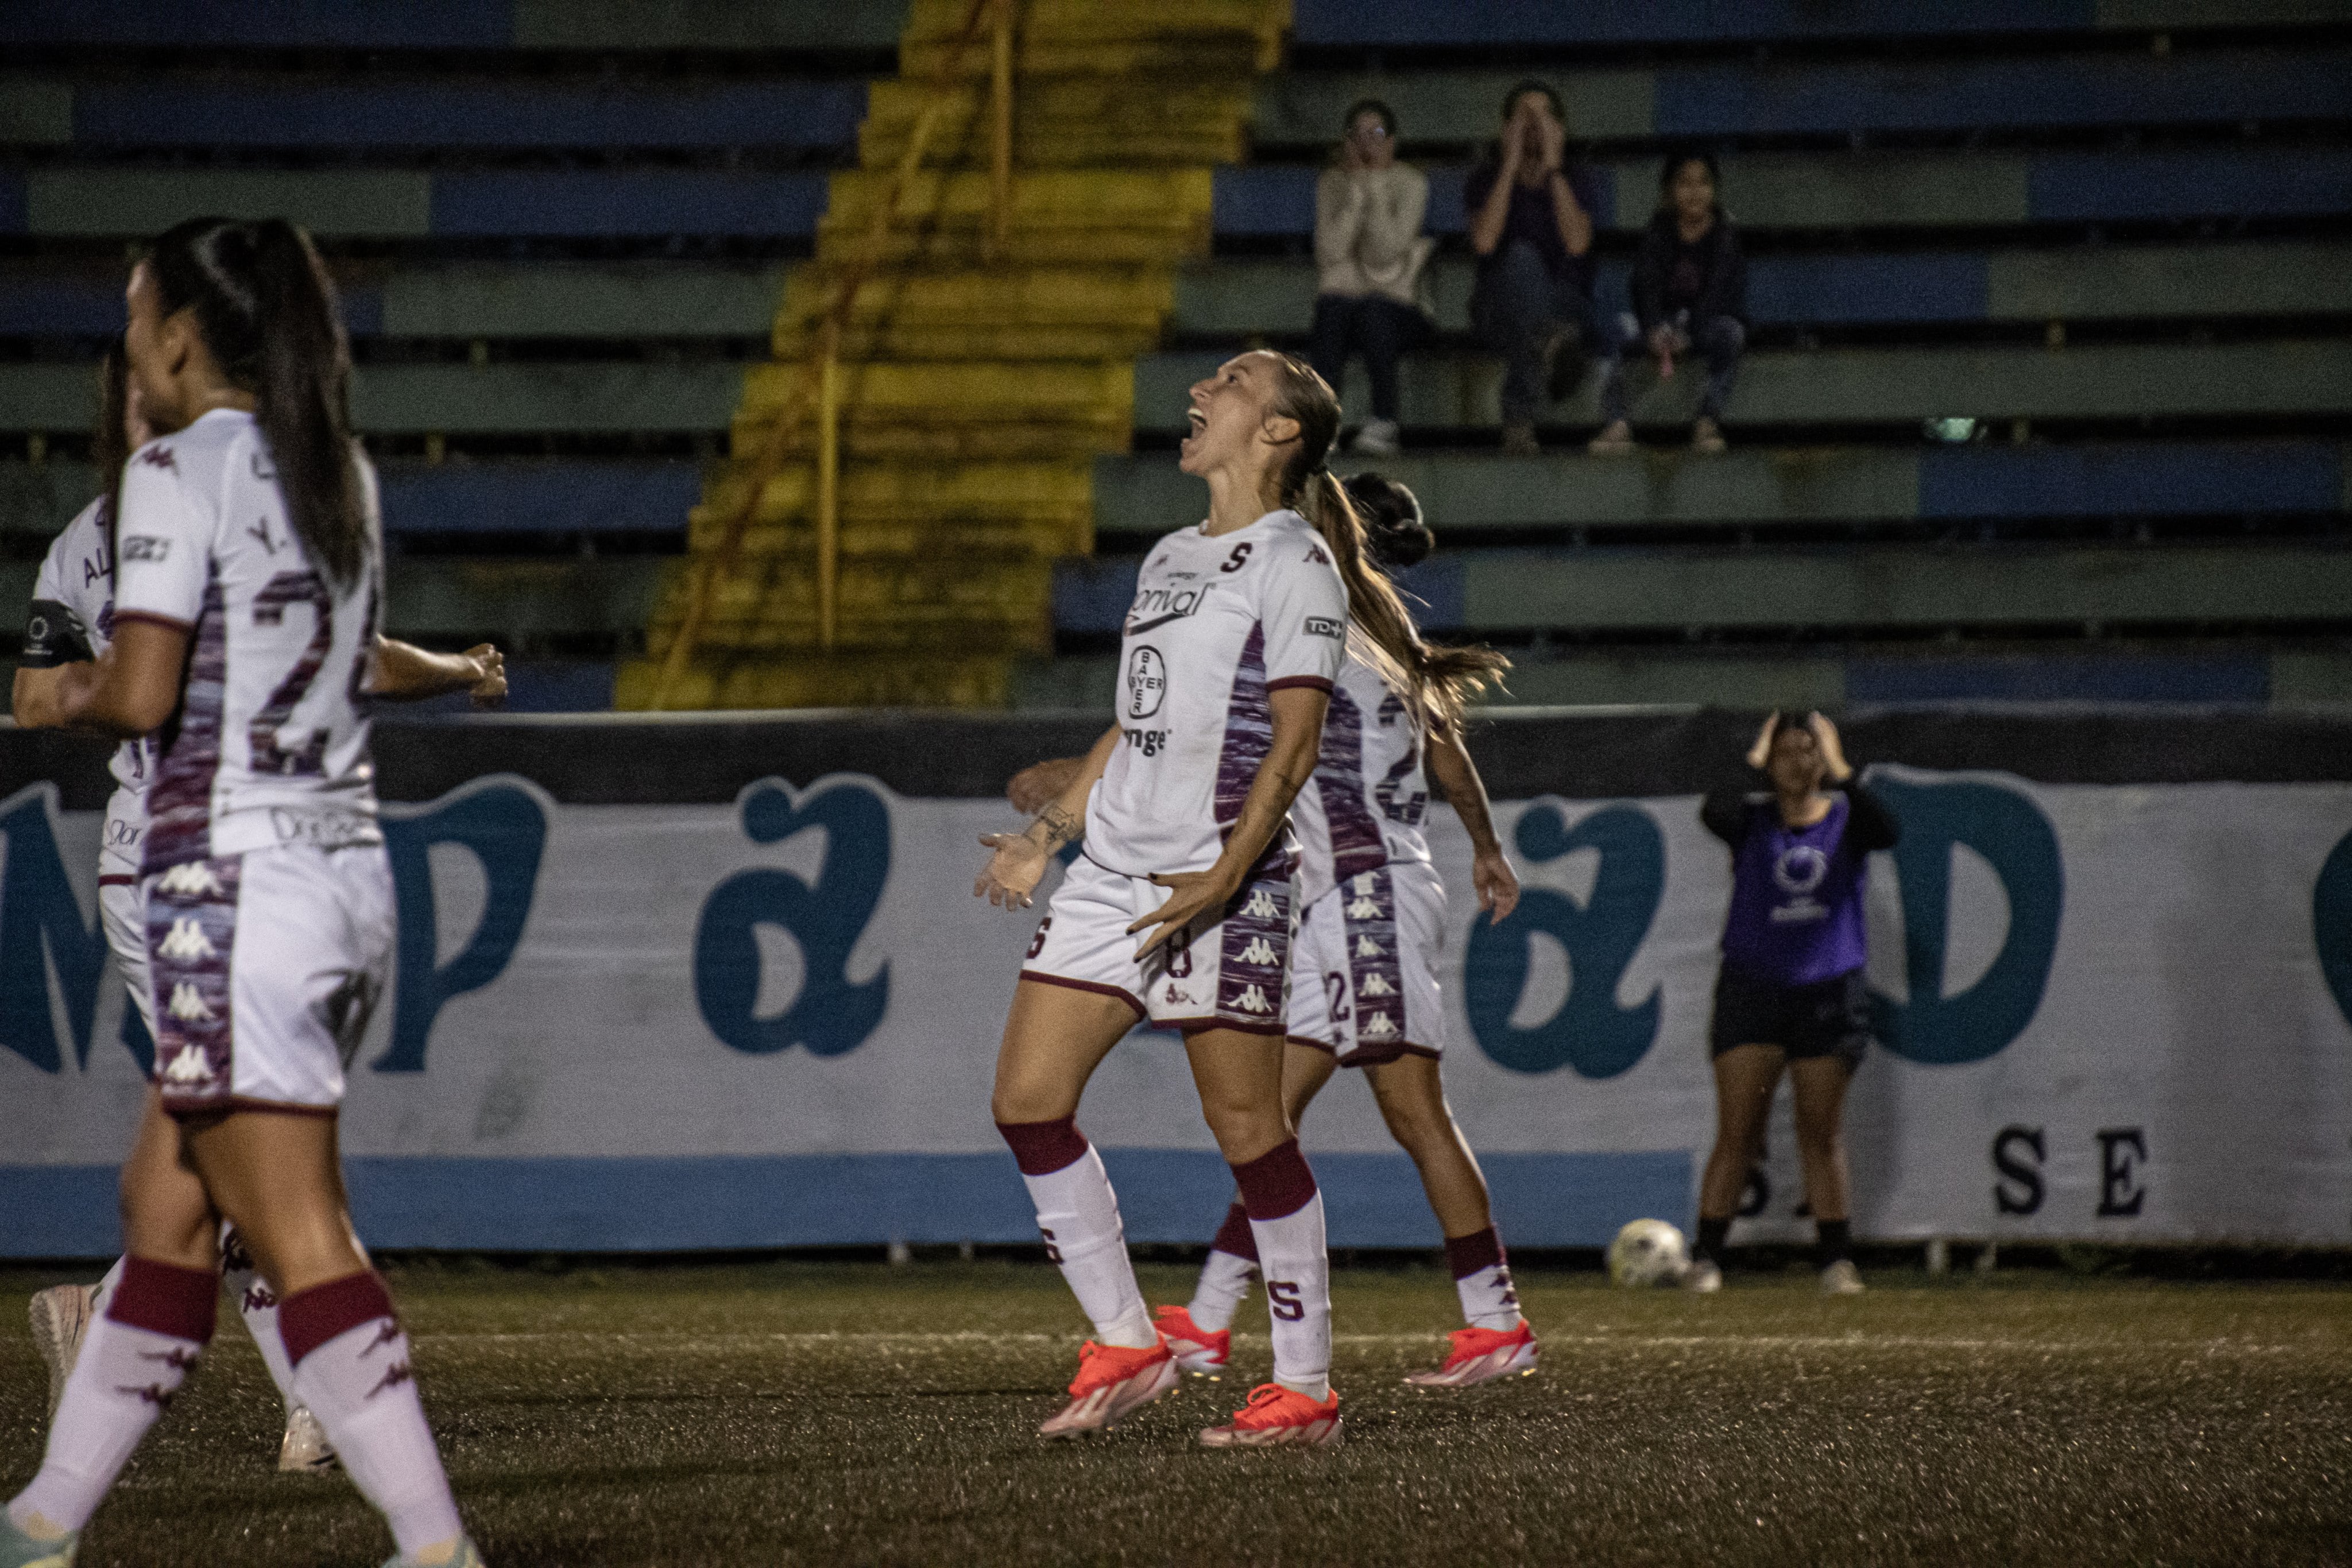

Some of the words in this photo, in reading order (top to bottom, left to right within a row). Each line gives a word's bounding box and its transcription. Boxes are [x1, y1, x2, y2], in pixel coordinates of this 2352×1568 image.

[1220, 541, 1252, 573] S
[248, 570, 332, 776] 2
[1267, 1281, 1305, 1322] S
